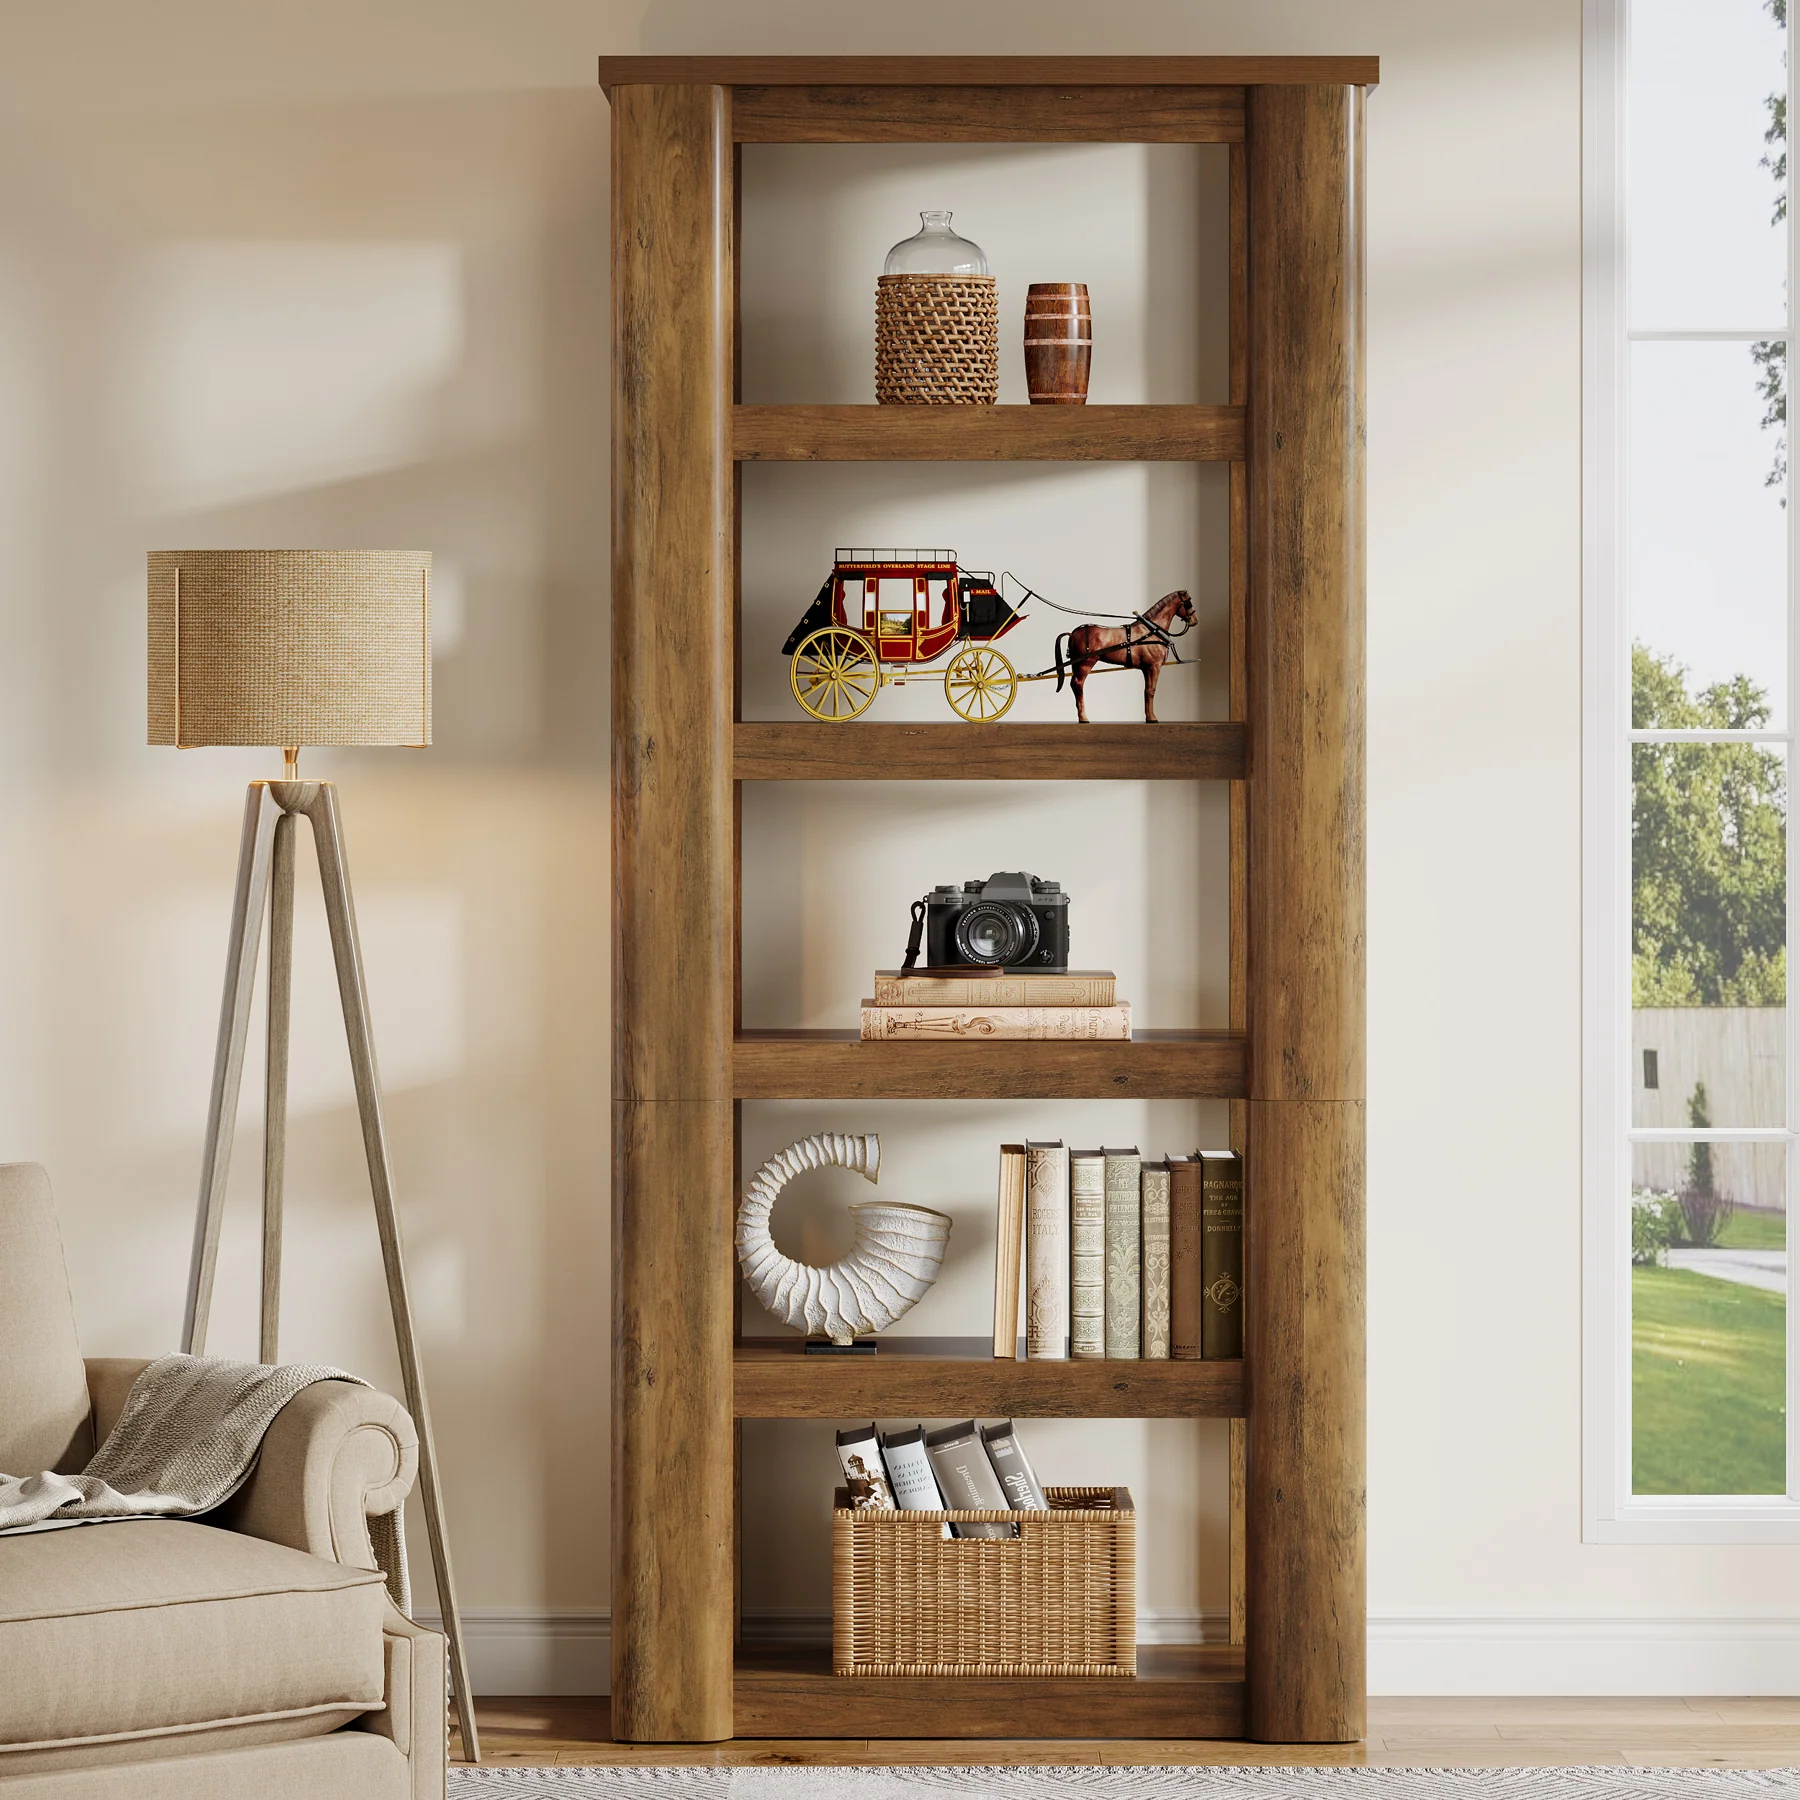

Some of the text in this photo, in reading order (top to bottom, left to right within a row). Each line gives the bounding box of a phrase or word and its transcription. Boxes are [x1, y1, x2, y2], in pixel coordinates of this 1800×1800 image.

[1087, 1009, 1102, 1039] Charm
[1032, 1208, 1061, 1220] ROGERS
[1108, 1204, 1139, 1213] FRIENDS
[1032, 1224, 1061, 1235] ITALY
